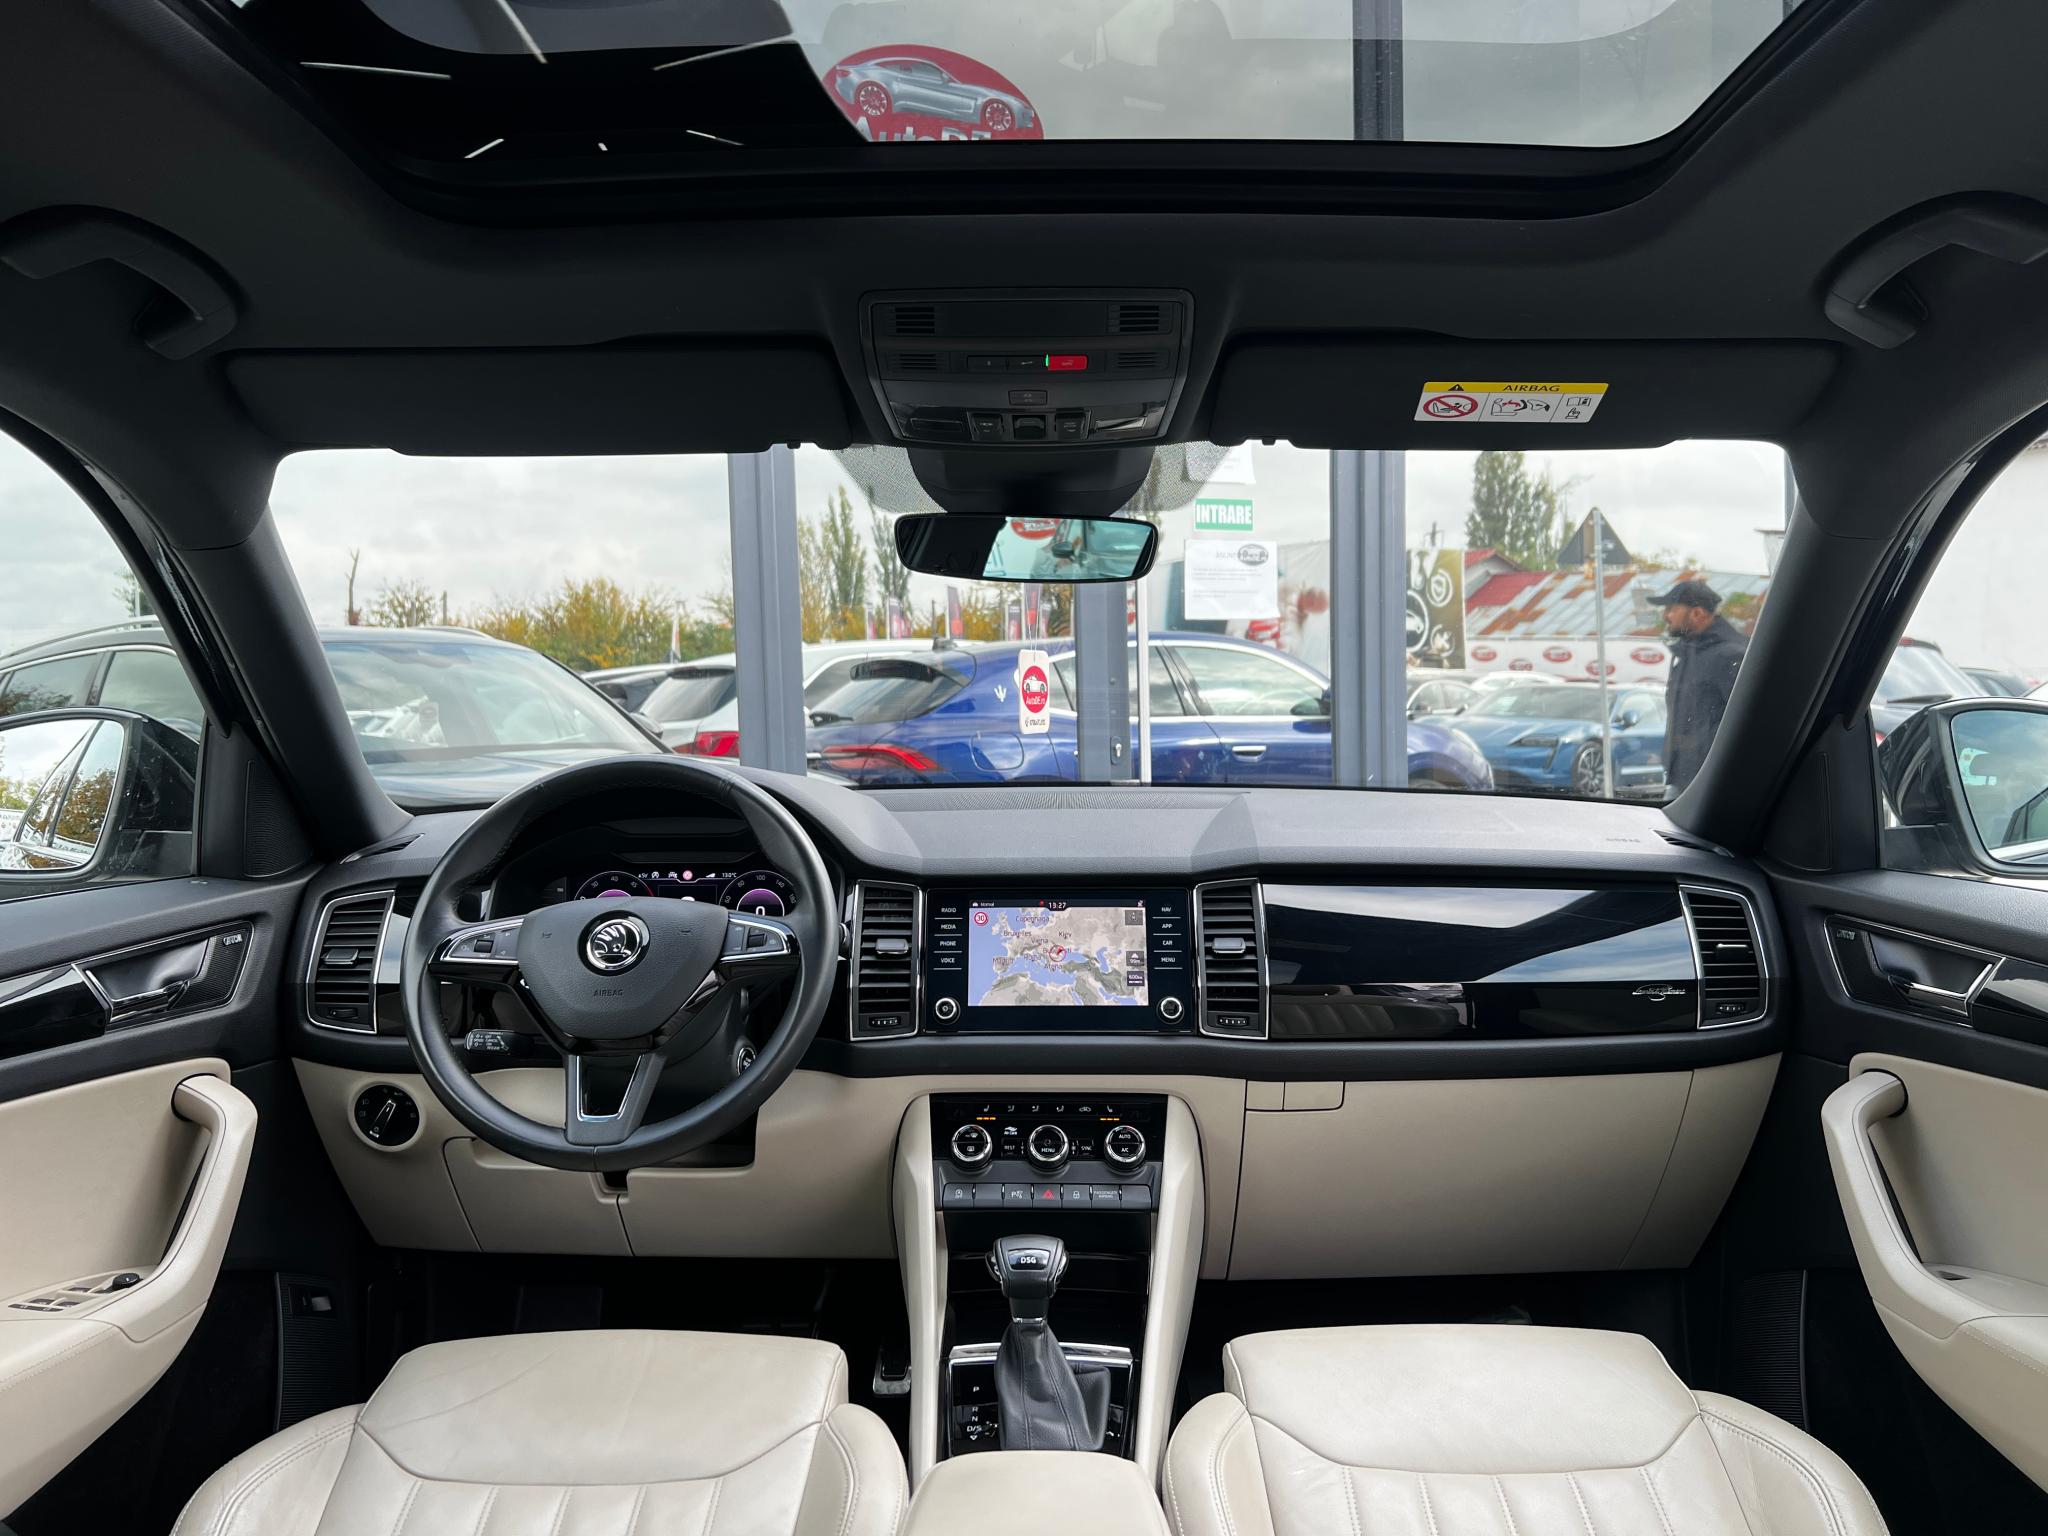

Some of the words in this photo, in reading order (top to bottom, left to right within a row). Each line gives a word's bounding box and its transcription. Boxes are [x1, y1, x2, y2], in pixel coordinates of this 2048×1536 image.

[1502, 384, 1561, 392] AIRBAG
[1196, 503, 1253, 525] INTRARE
[593, 989, 623, 997] AIRBAG
[1020, 1256, 1037, 1264] DSG
